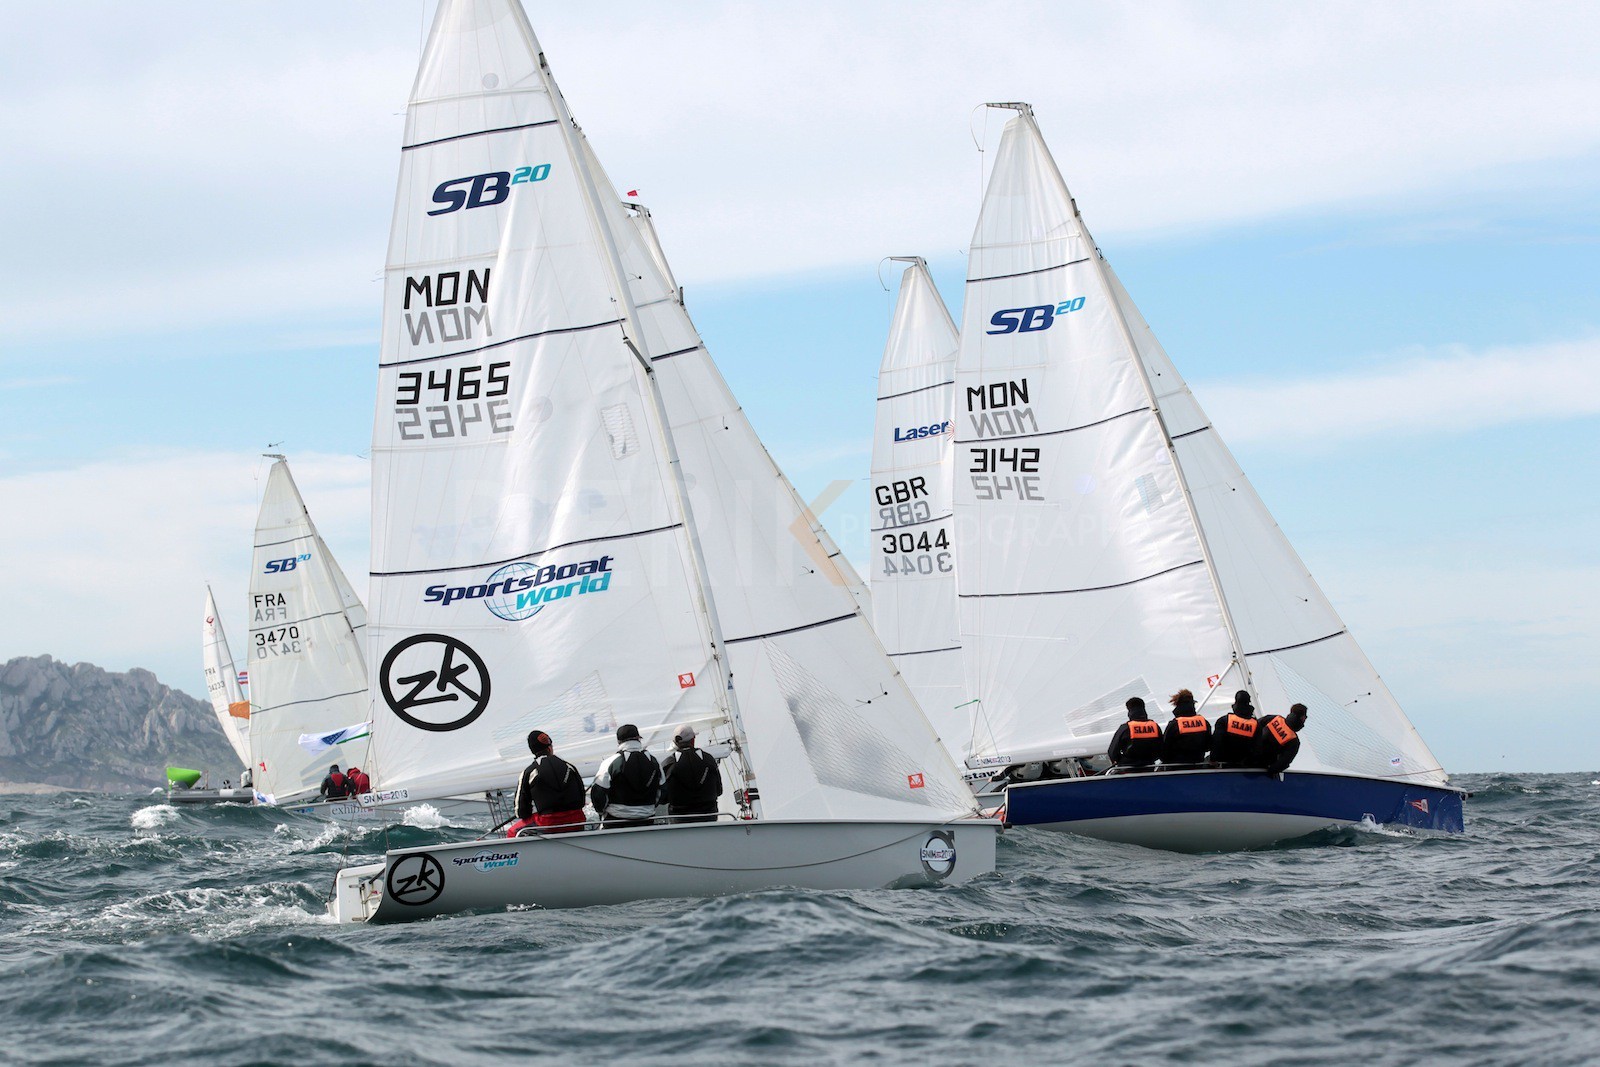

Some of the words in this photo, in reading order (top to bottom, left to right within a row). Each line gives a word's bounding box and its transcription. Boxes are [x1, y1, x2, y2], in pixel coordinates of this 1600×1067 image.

[404, 268, 491, 310] MON
[396, 361, 511, 405] 3465
[967, 378, 1030, 412] MON
[894, 420, 950, 442] Laser
[970, 448, 1040, 473] 3142
[875, 476, 929, 506] GBR
[882, 528, 950, 554] 3044
[424, 555, 614, 606] SportsBoat
[254, 592, 286, 608] FRA
[516, 572, 611, 611] World
[255, 626, 299, 646] 3470
[204, 666, 216, 677] FRA
[1133, 725, 1156, 735] SLAM
[1182, 719, 1203, 729] SLAM
[1231, 720, 1253, 733] SLAM
[1271, 720, 1288, 740] SLAM
[363, 793, 383, 804] SNM
[390, 789, 409, 800] 2013
[483, 857, 519, 869] World
